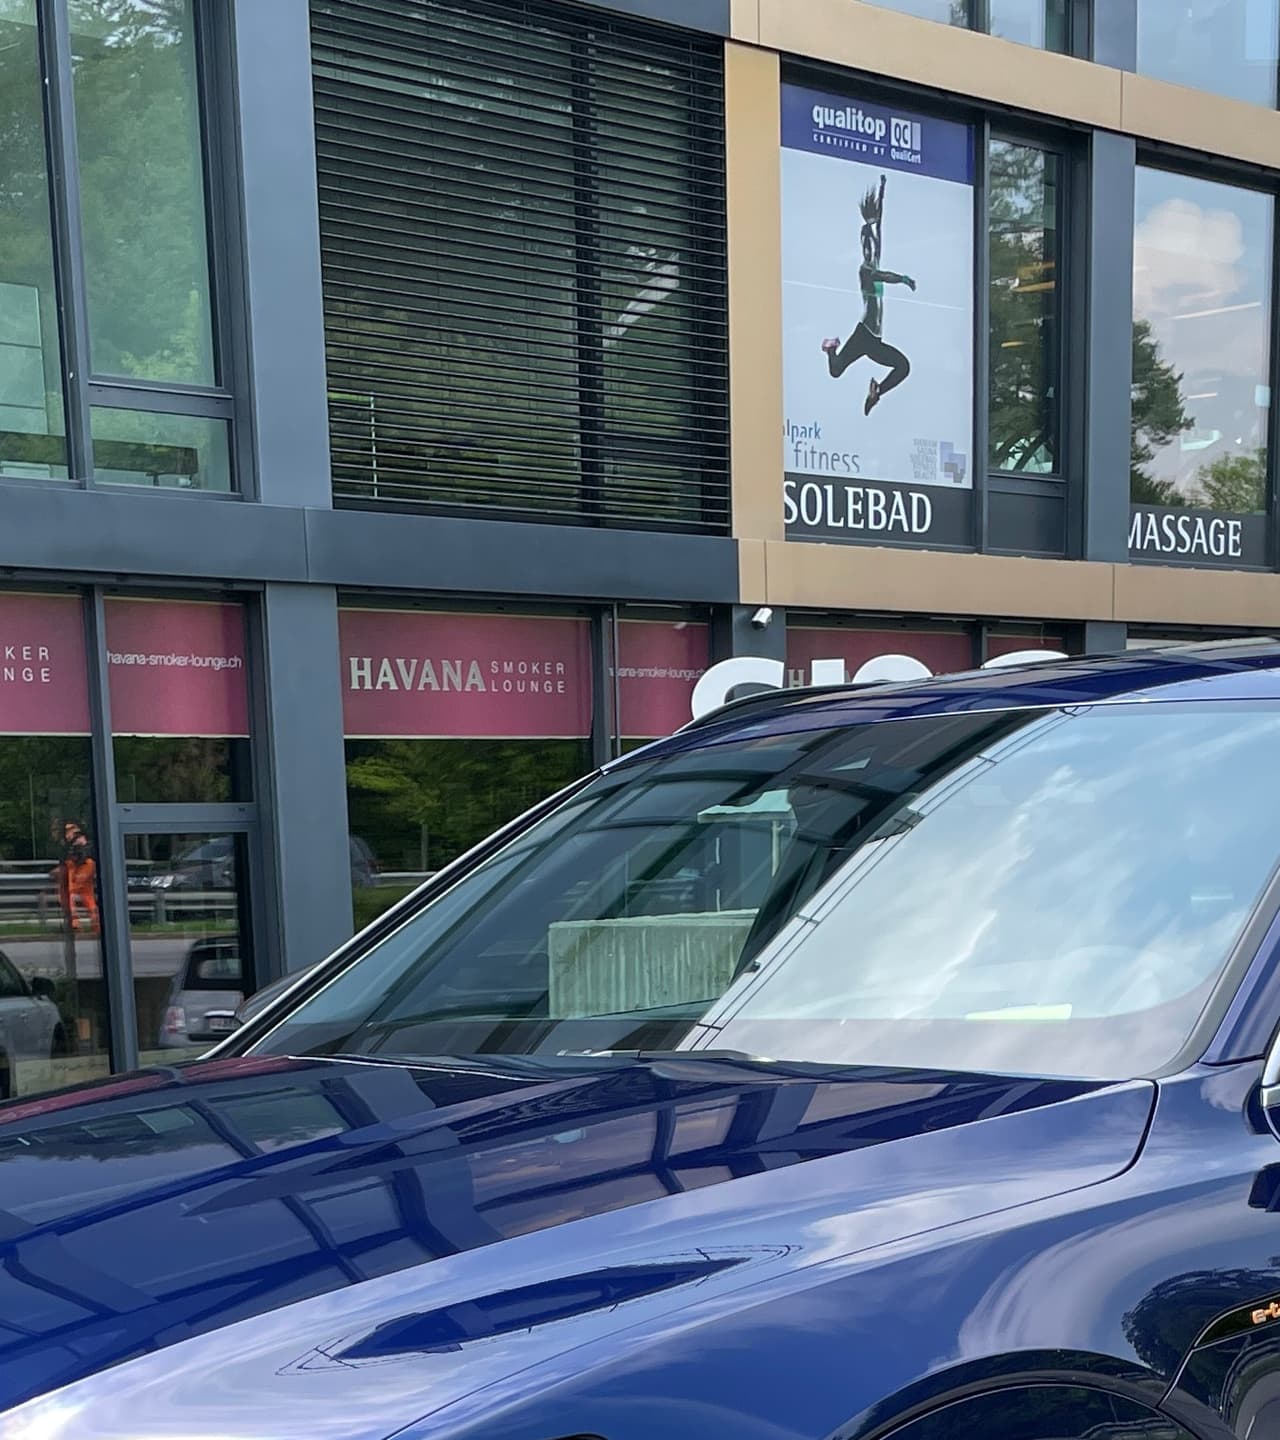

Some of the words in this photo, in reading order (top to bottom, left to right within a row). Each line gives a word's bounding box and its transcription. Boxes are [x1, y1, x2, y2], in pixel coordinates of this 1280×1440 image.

[812, 104, 886, 141] qualitop
[793, 441, 860, 473] fitness
[784, 480, 932, 533] SOLEBAD
[107, 650, 242, 670] havana-smoker-lounge.ch
[349, 657, 486, 692] HAVANA
[490, 661, 566, 675] SMOKER
[491, 679, 566, 693] LOUNGE
